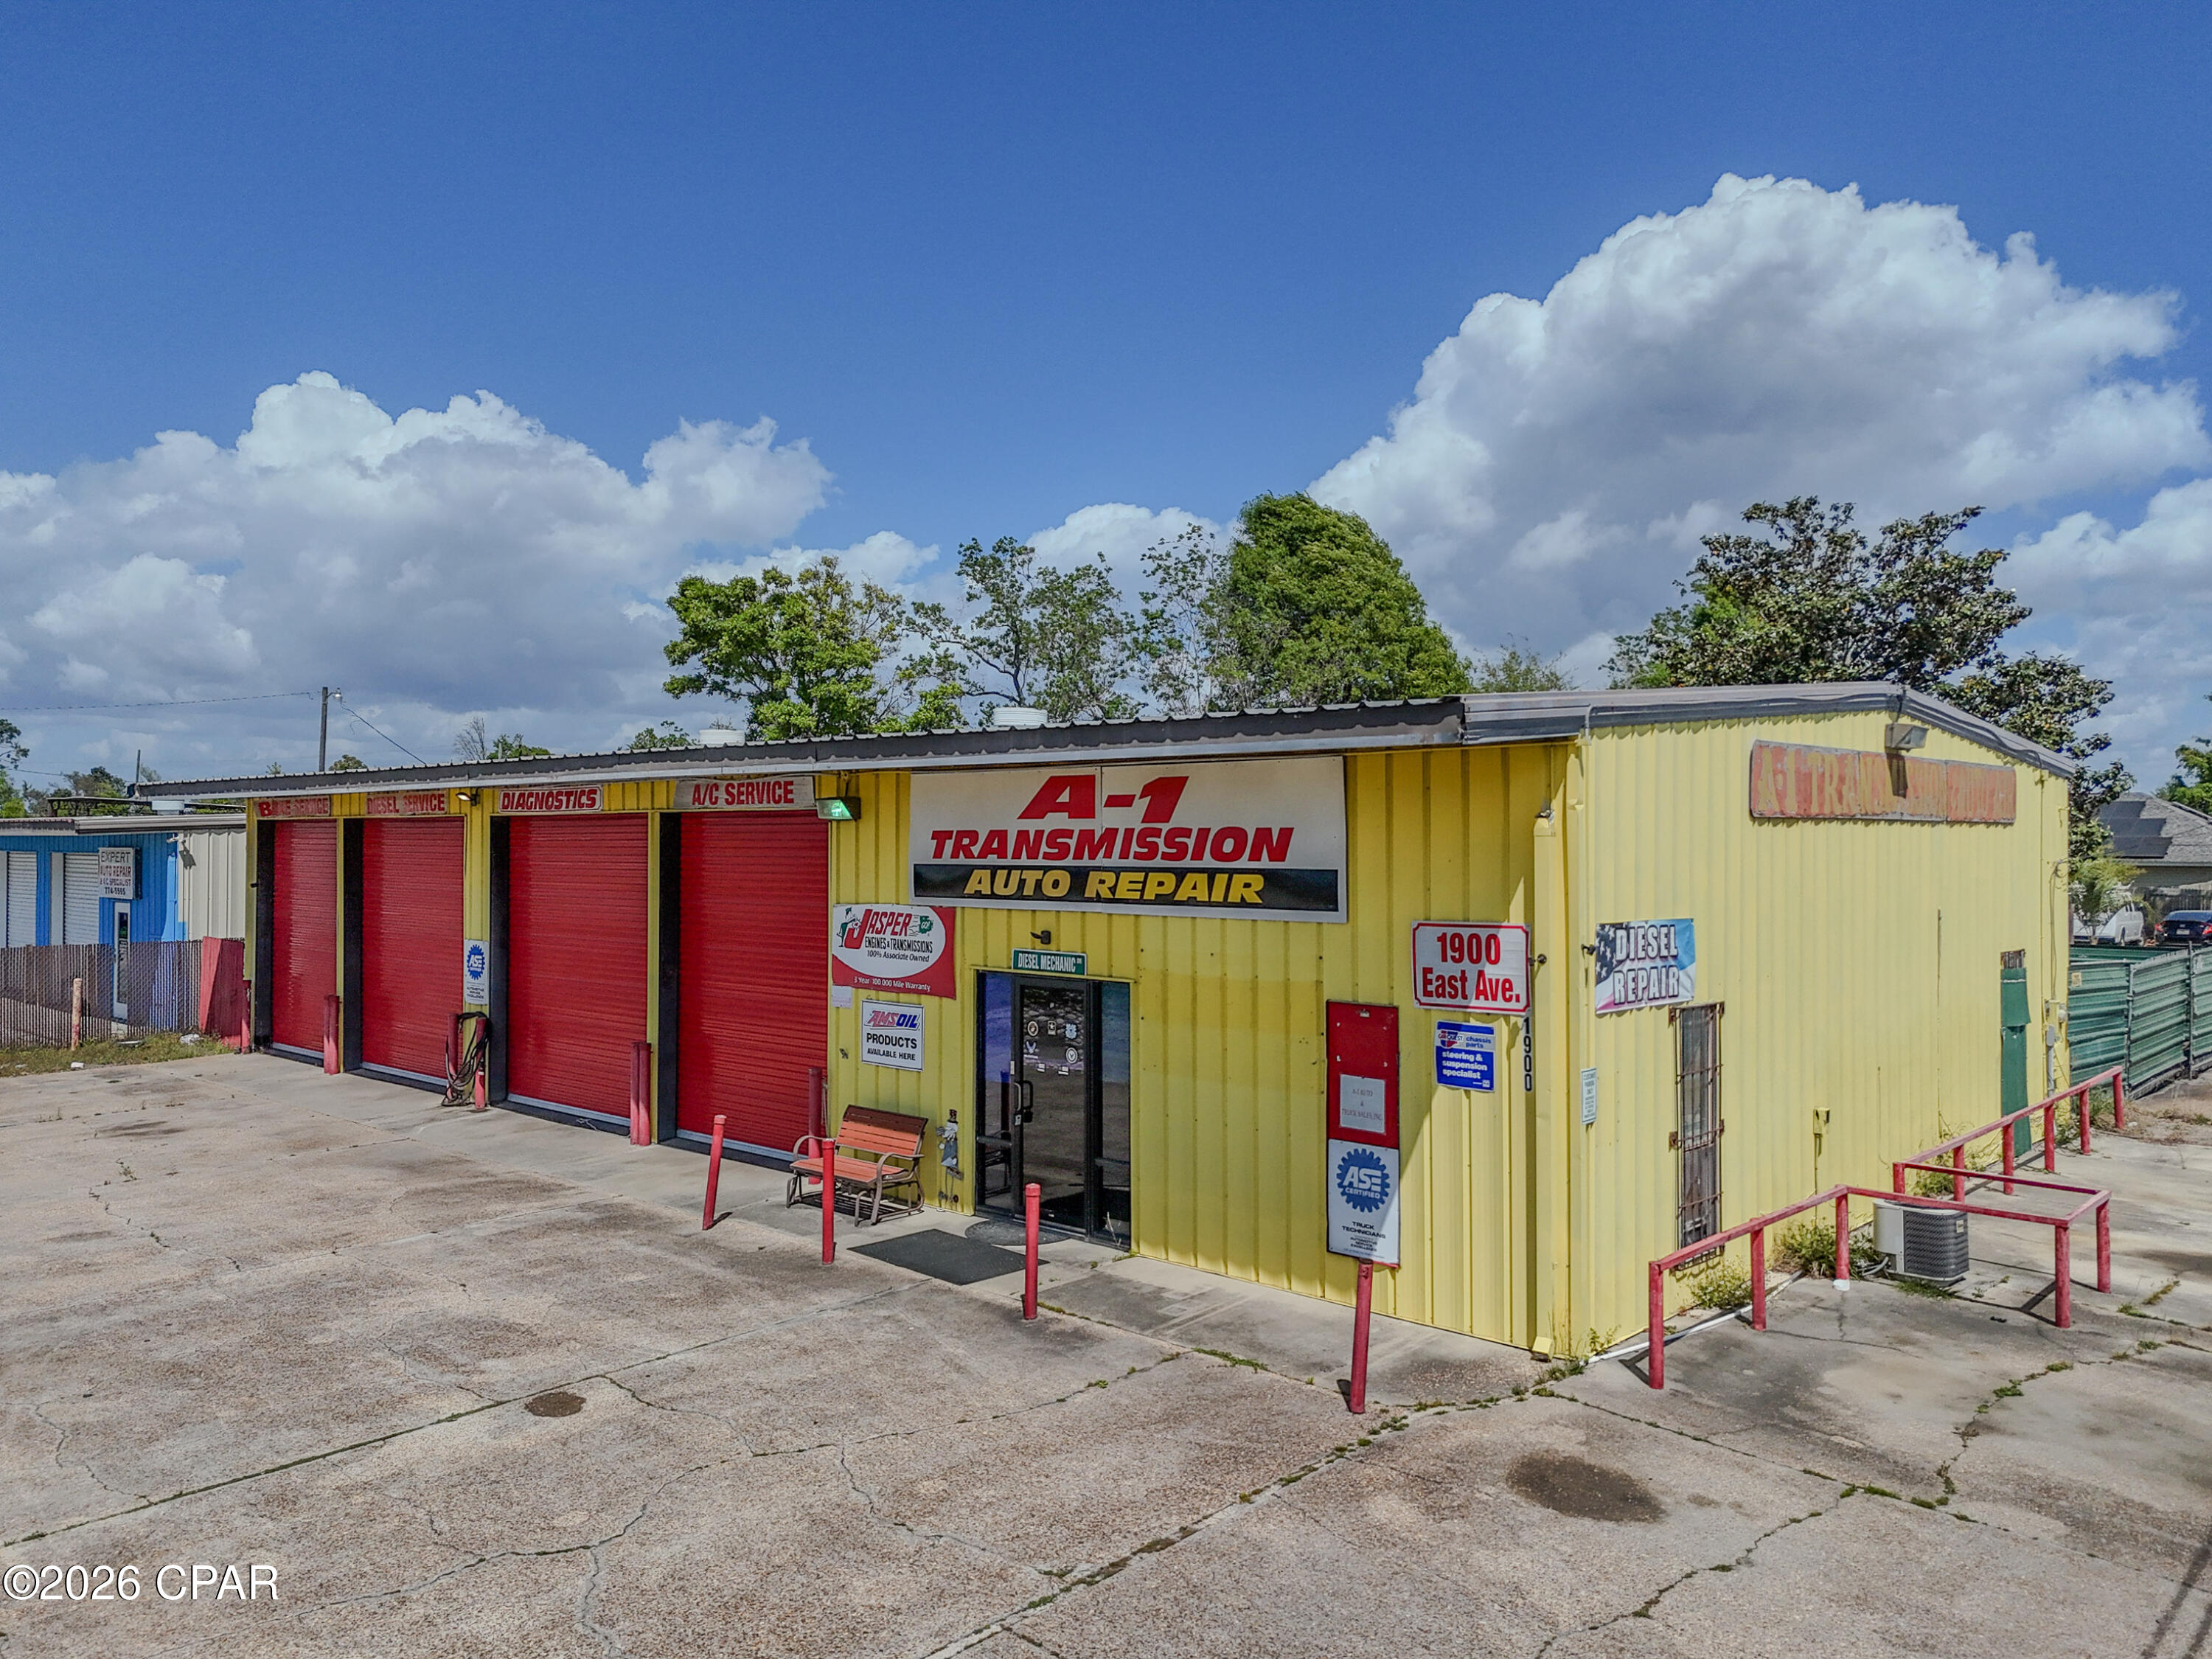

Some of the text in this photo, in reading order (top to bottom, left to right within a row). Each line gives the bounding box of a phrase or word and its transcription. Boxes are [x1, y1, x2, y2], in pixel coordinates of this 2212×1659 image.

[501, 789, 597, 810] DIAGNOSTICS
[692, 781, 794, 806] A/C SERVICE
[1017, 774, 1189, 824] A-1
[367, 793, 445, 814] DIESEL SERVICE
[931, 827, 1294, 863] TRANSMISSION
[100, 851, 131, 863] EXPERT
[113, 866, 131, 877] REPAIR
[963, 869, 1264, 903] AUTO REPAIR
[844, 908, 912, 950] JASPER
[865, 936, 886, 950] ENGINES
[890, 937, 933, 954] TRANSMISSIONS
[1436, 932, 1501, 965] 1900
[1614, 924, 1678, 961] DIESEL
[468, 954, 483, 967] ASE
[867, 950, 930, 963] 100% Associate Owned
[1018, 953, 1040, 970] DIESEL
[1040, 955, 1077, 973] MECHANIC
[893, 980, 905, 988] Mile
[905, 981, 931, 992] Warranty
[1422, 967, 1520, 1004] East Ave.
[1613, 964, 1680, 1006] REPAIR
[867, 1010, 918, 1028] AMSOIL
[866, 1032, 917, 1049] PRODUCTS
[1465, 1036, 1492, 1044] chassis
[867, 1048, 916, 1061] AVAILABLE HERE
[1441, 1050, 1483, 1062] steering &
[1523, 1016, 1532, 1092] 1900
[1441, 1060, 1488, 1071] suspension
[1442, 1068, 1481, 1079] specialist
[1342, 1165, 1382, 1192] ASE
[1345, 1186, 1381, 1200] CERTIFIED
[1342, 1225, 1386, 1239] TECHNICIANS
[1352, 1220, 1375, 1231] TRUCK
